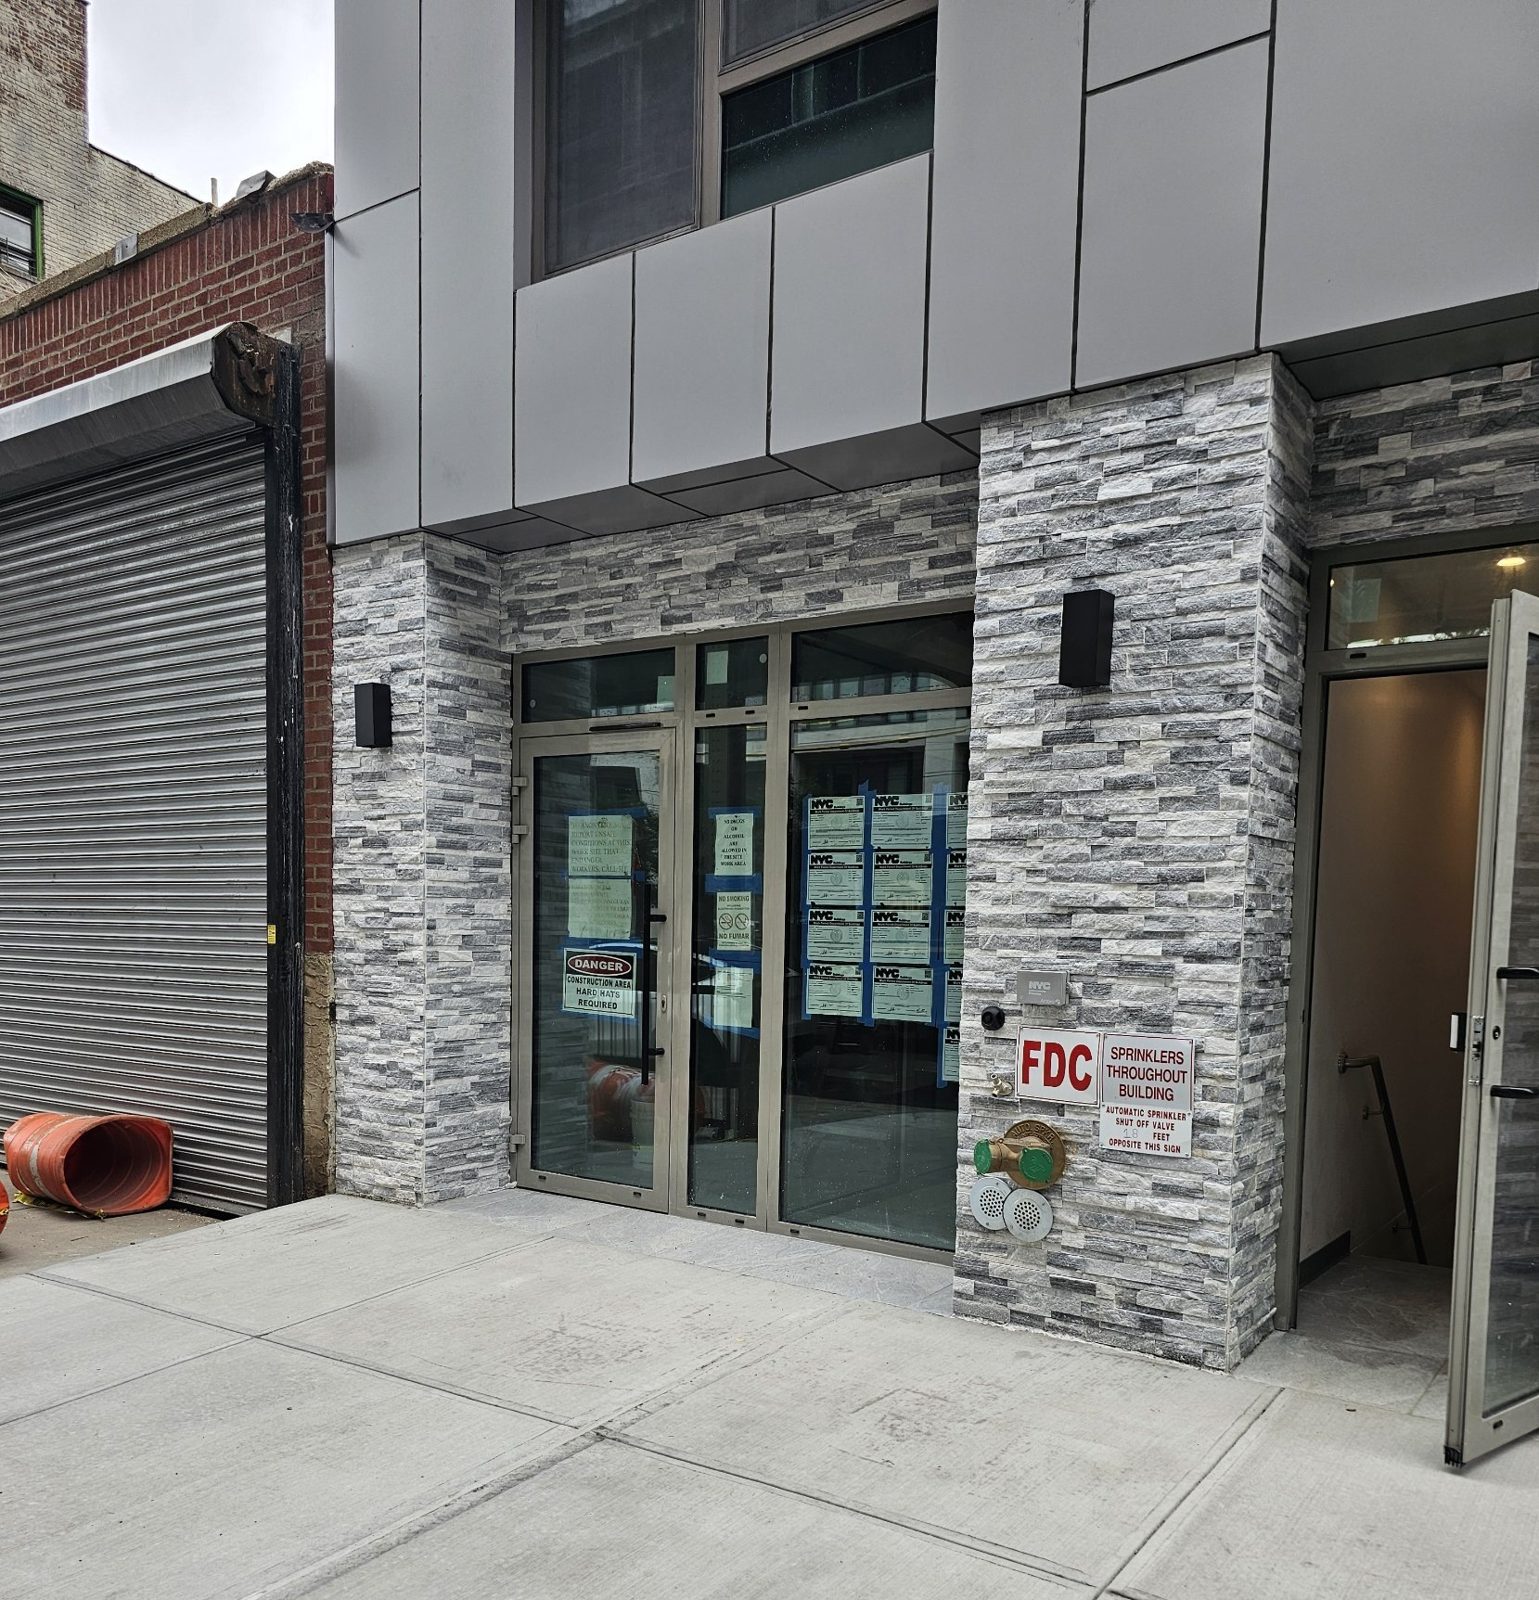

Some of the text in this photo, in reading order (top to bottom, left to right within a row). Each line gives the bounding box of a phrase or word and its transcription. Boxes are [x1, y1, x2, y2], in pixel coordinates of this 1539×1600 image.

[812, 800, 833, 809] NYC
[875, 796, 899, 806] NYC
[950, 794, 968, 805] NY
[811, 855, 833, 864] NYC
[876, 854, 899, 864] NYC
[950, 853, 967, 863] NY
[810, 911, 833, 920] NYC
[874, 912, 898, 921] NYC
[948, 912, 966, 921] NY
[574, 959, 623, 971] DANGER
[810, 965, 832, 975] NYC
[876, 968, 899, 978] NYC
[949, 970, 964, 979] NY
[567, 976, 631, 989] CONSTRUCTION AREA
[1029, 981, 1051, 990] NYC
[576, 988, 620, 998] HARD HATS
[578, 999, 618, 1009] REQUIRED
[1111, 1047, 1184, 1065] SPRINKLERS
[1022, 1040, 1092, 1091] FDC
[1106, 1065, 1187, 1084] THROUGHOUT
[1120, 1084, 1174, 1101] BUILDING
[1106, 1106, 1186, 1120] AUTOMATIC SPRINKLER
[1116, 1118, 1175, 1131] SHUT OFF VALVE
[1153, 1132, 1170, 1141] FEET
[1109, 1138, 1181, 1153] OPPOSITE THIS SIGN
